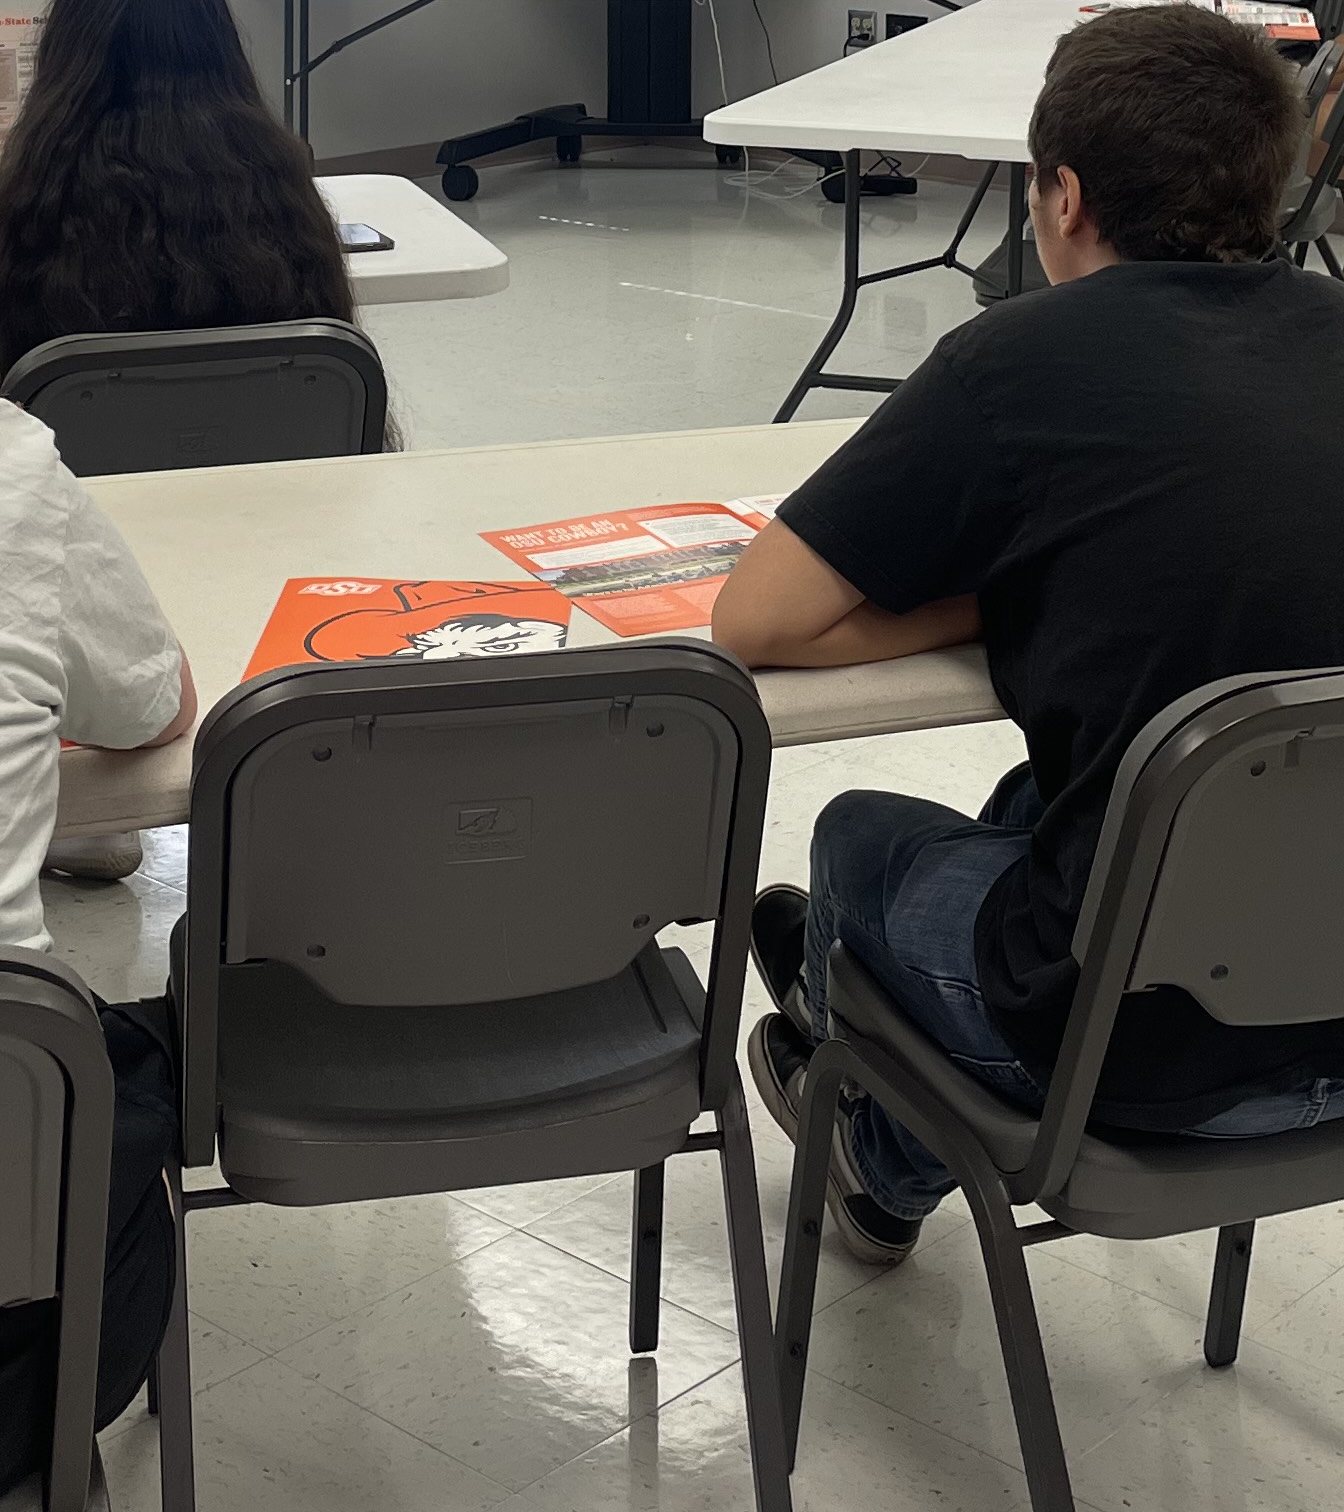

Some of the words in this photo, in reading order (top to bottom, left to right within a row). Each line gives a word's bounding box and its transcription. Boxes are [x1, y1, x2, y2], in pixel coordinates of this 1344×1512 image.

[499, 531, 545, 543] WANT
[545, 527, 566, 536] TO
[568, 523, 586, 532] BE
[590, 519, 614, 529] AN
[509, 537, 546, 549] OSU
[546, 522, 630, 544] COWBOY?
